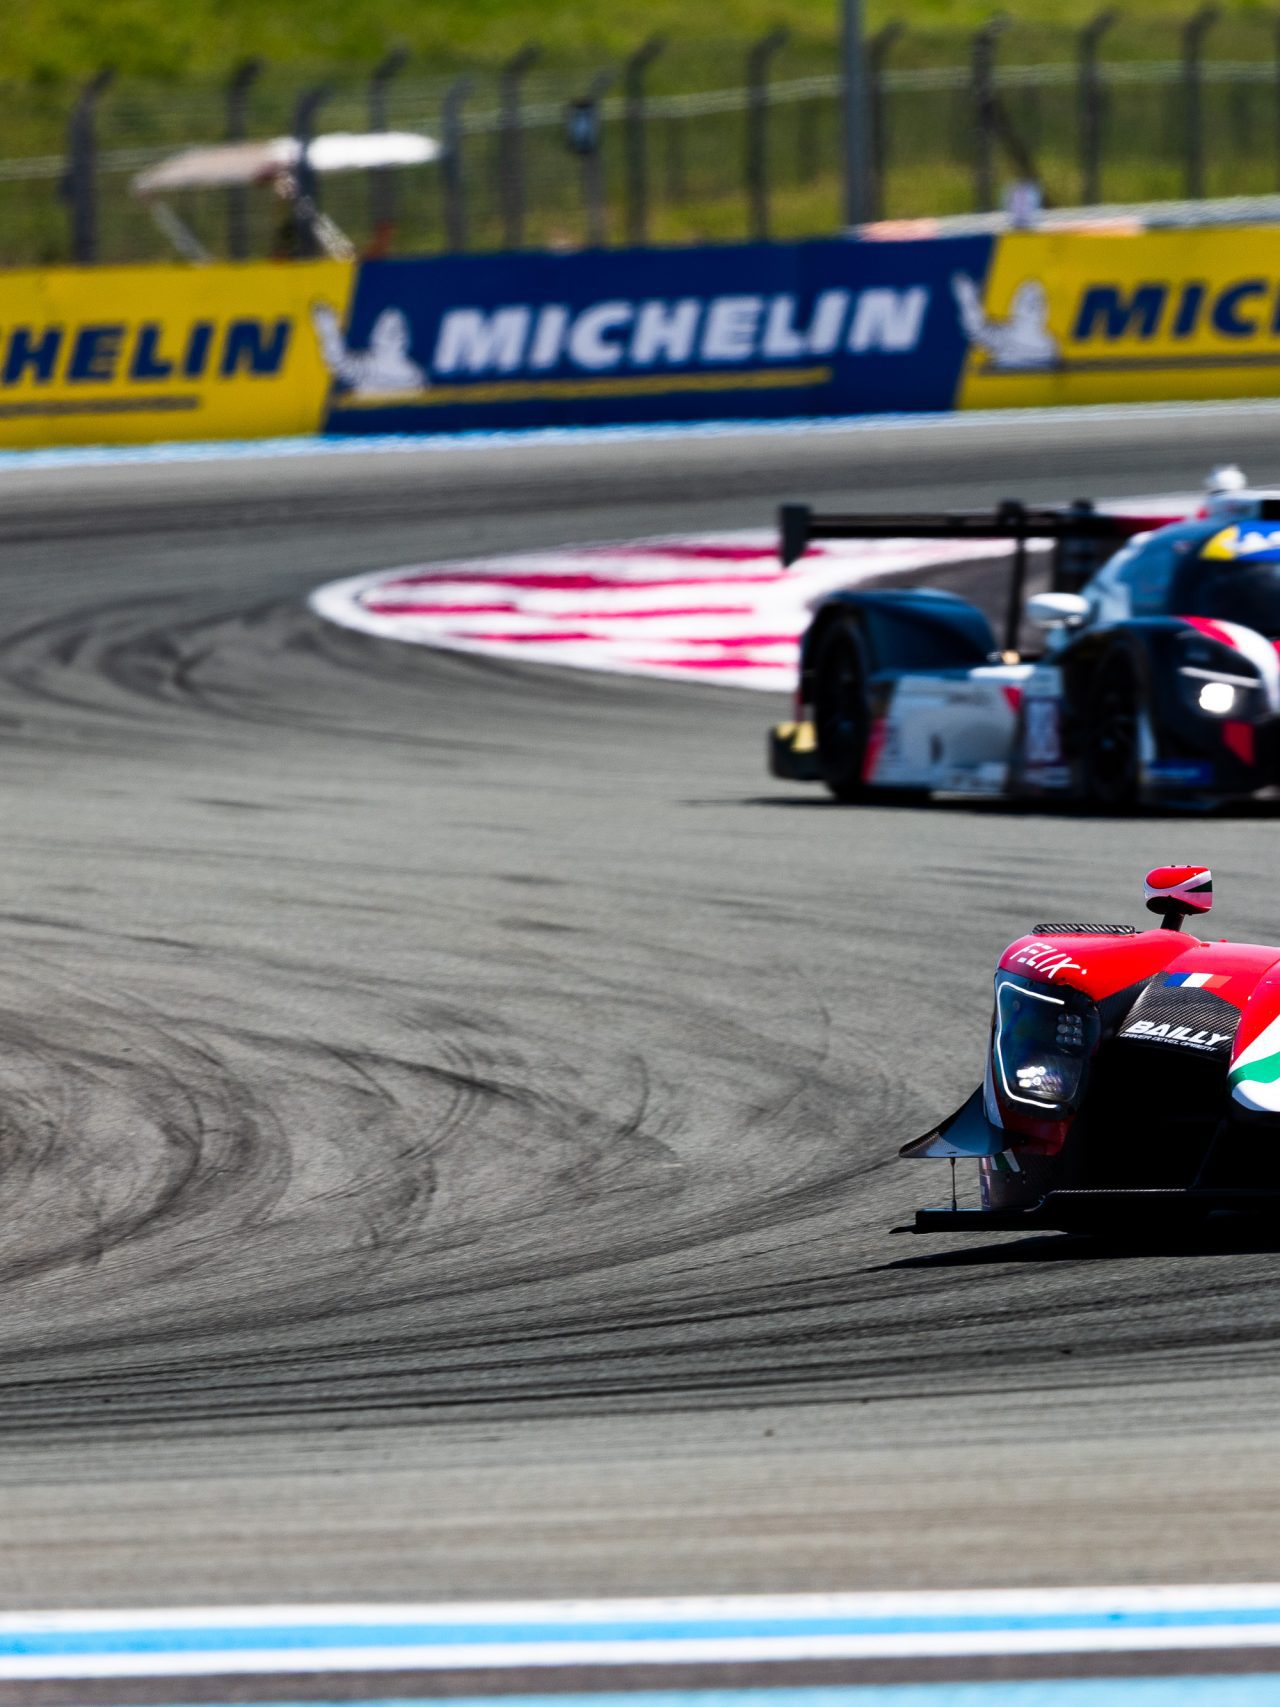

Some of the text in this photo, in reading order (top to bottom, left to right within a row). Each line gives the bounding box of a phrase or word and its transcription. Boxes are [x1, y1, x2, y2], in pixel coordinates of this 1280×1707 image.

[432, 286, 930, 374] MICHELIN
[1009, 942, 1081, 979] FELIX
[1120, 1032, 1218, 1052] DRIVER DEVELOPMENT
[1125, 1020, 1232, 1046] BAILLY
